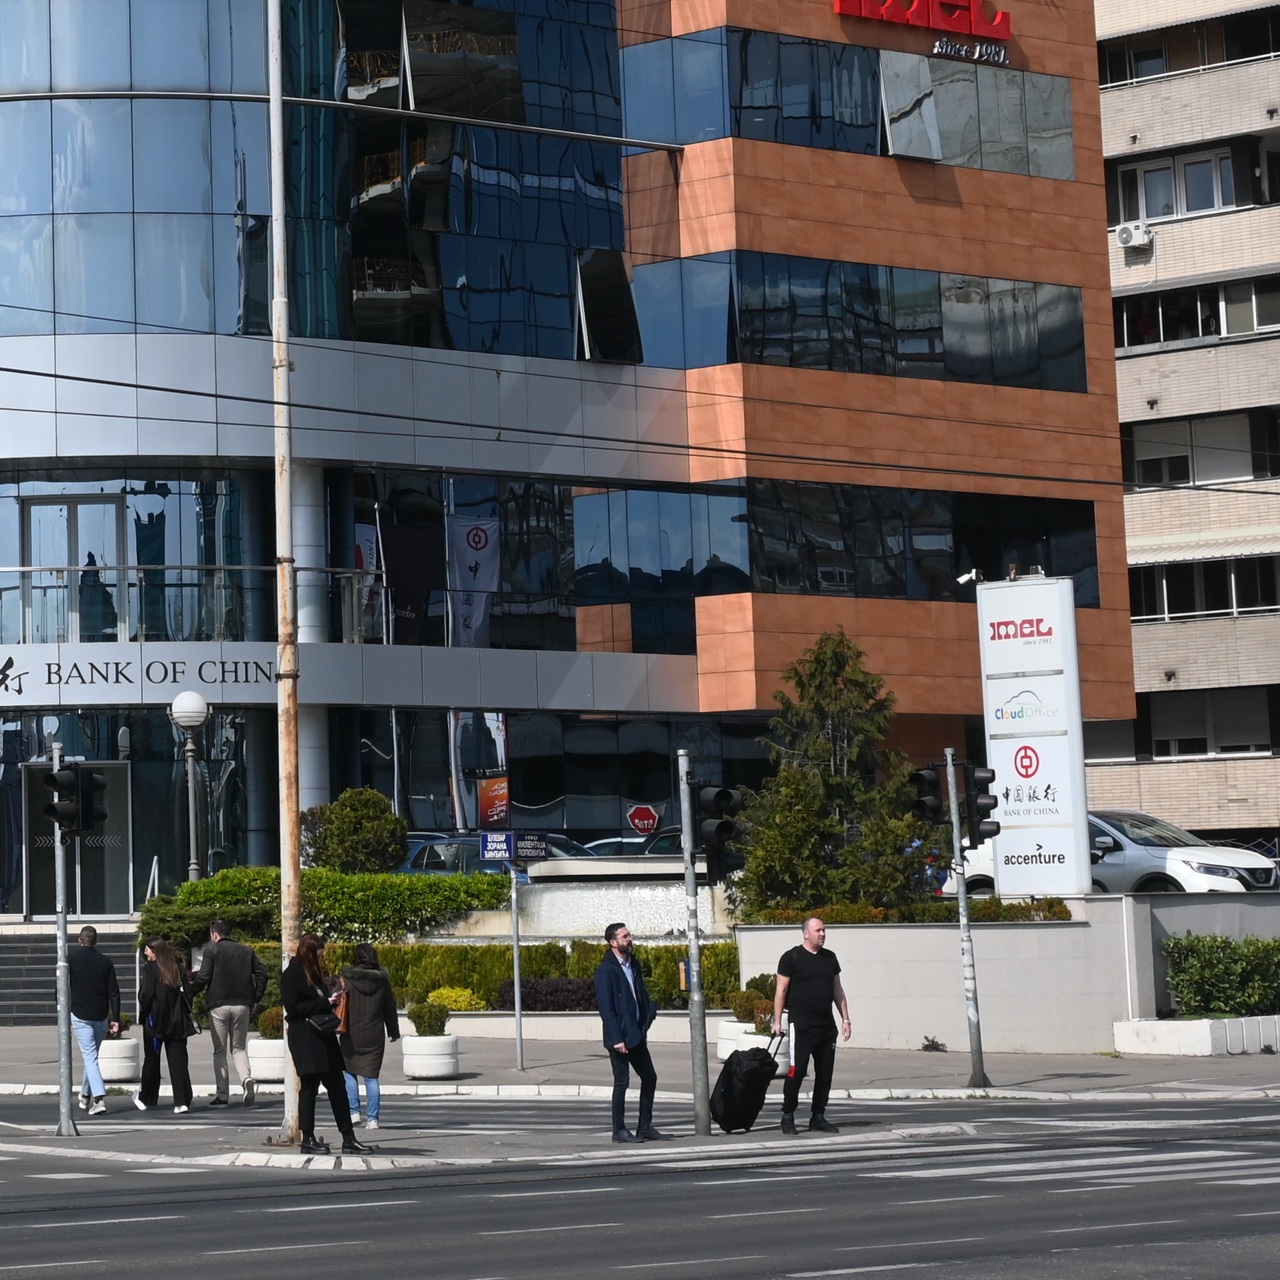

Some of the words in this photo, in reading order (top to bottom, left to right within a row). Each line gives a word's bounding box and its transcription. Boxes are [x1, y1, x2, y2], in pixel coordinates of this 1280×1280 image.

[932, 37, 972, 58] since
[1022, 638, 1037, 646] since
[44, 662, 135, 685] BANK
[145, 661, 187, 684] OF
[197, 660, 279, 684] CHIN
[1003, 809, 1022, 817] BANK
[1022, 808, 1033, 816] OF
[1033, 807, 1060, 815] CHINA
[486, 842, 507, 850] ЗОРАНА
[1003, 852, 1066, 866] accenture
